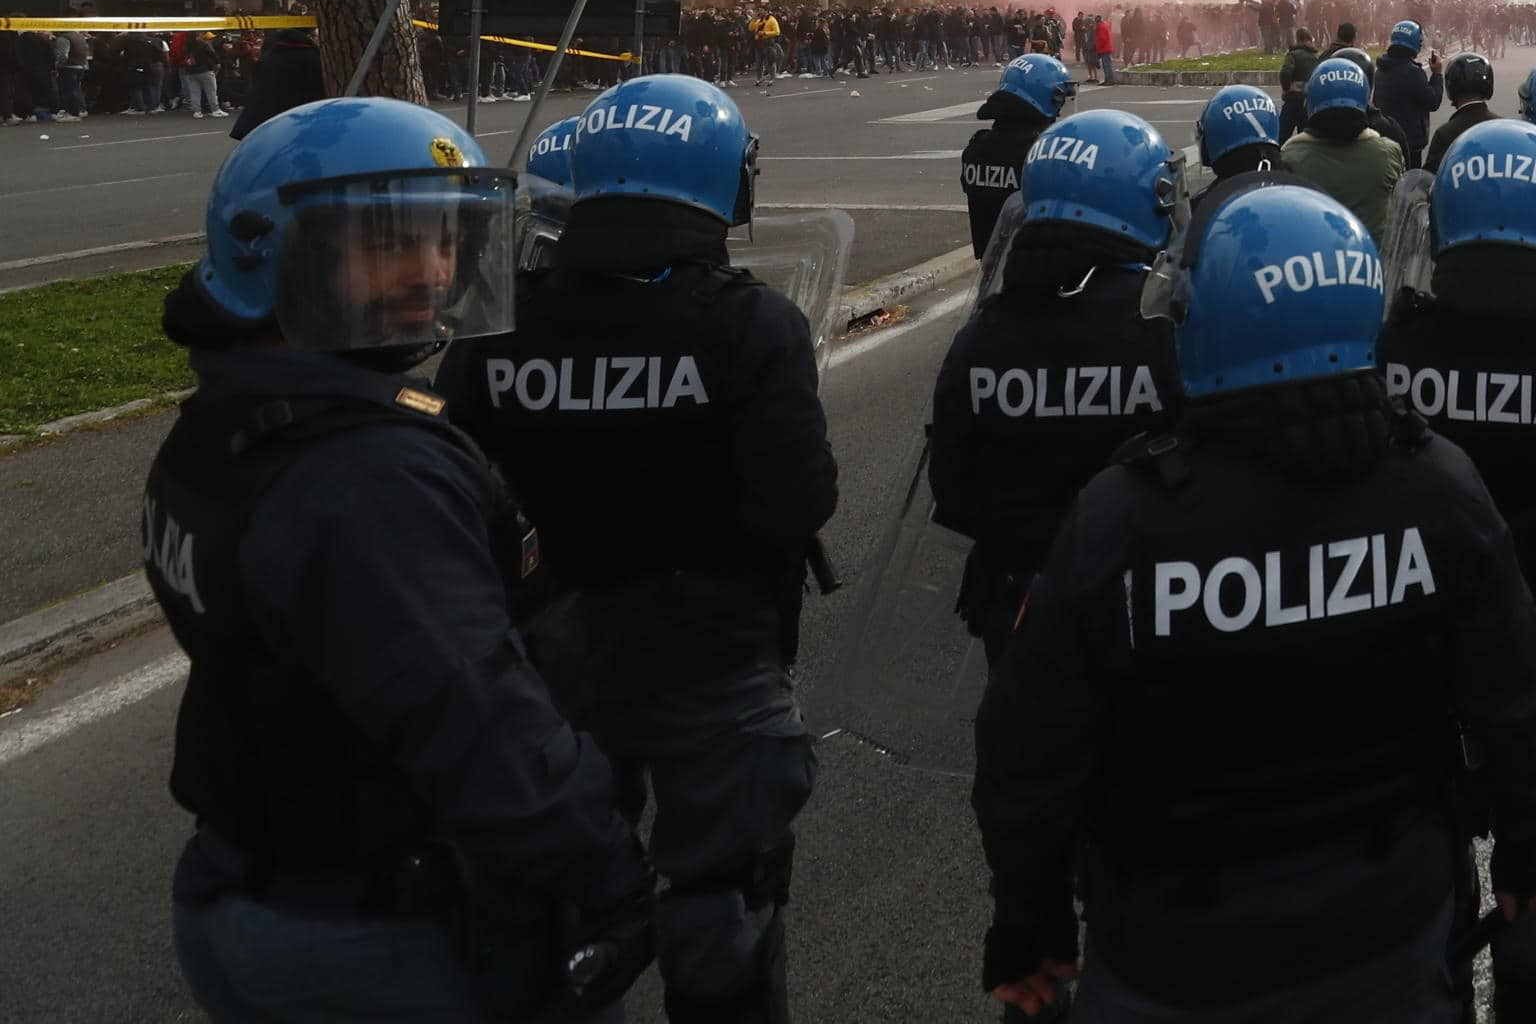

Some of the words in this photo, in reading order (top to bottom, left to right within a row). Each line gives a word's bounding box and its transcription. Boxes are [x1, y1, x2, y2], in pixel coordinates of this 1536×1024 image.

[1319, 70, 1364, 87] POLIZIA
[576, 104, 693, 143] POLIZIA
[1223, 97, 1277, 120] POLIZIA
[529, 134, 571, 163] POLI
[1254, 250, 1384, 305] POLIZIA
[487, 355, 709, 411] POLIZIA
[970, 365, 1162, 417] POLIZIA
[1155, 528, 1436, 637] POLIZIA
